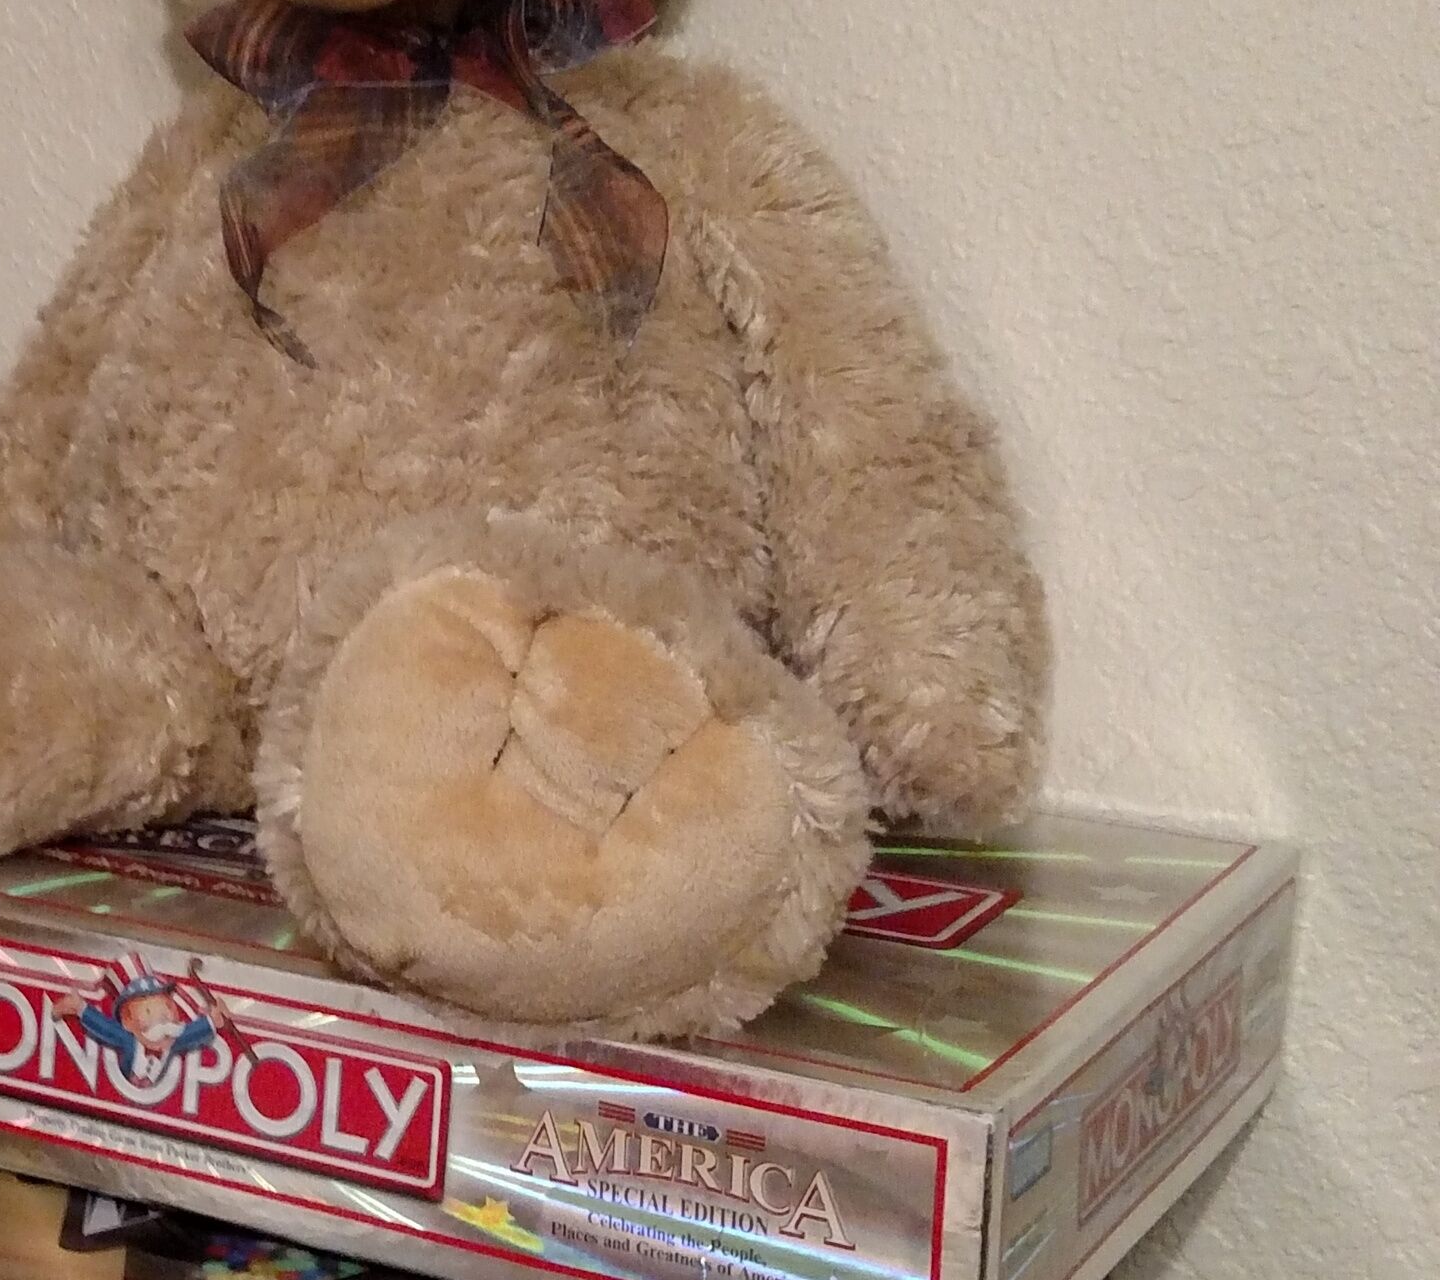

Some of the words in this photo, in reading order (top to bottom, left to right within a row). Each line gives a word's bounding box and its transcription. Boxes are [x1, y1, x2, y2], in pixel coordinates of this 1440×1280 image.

[658, 1116, 710, 1138] THE
[510, 1108, 856, 1251] AMERICA
[587, 1178, 674, 1216] SPECIAL
[680, 1200, 769, 1236] EDITION
[551, 1221, 599, 1246] Places
[603, 1236, 631, 1253] and
[636, 1238, 712, 1270] Greatness
[717, 1260, 733, 1277] of
[588, 1212, 676, 1247] Celebrating
[680, 1233, 704, 1250] the
[711, 1239, 768, 1267] People,
